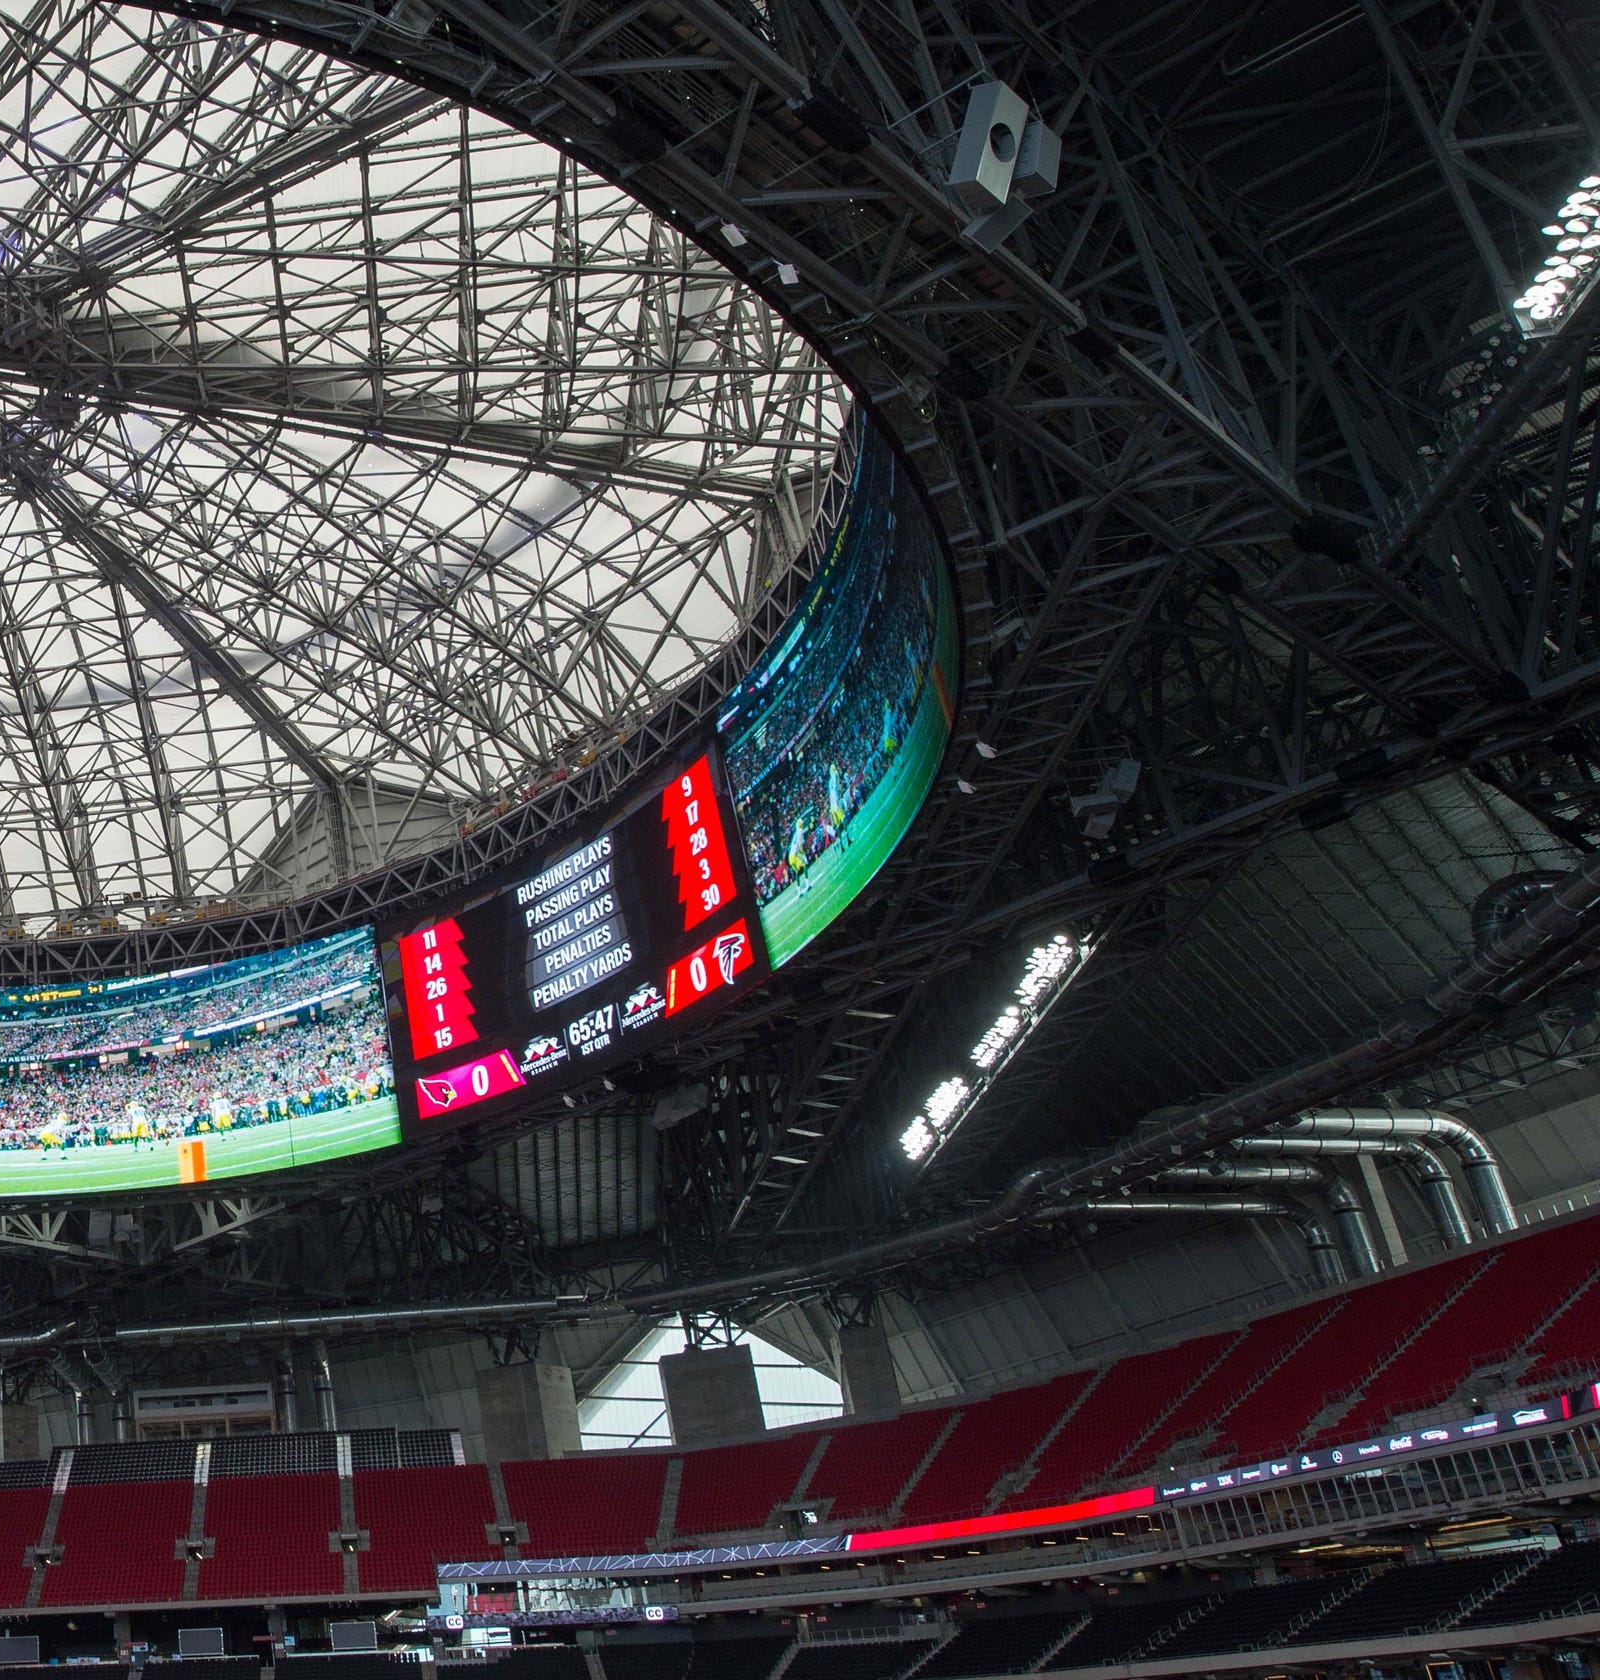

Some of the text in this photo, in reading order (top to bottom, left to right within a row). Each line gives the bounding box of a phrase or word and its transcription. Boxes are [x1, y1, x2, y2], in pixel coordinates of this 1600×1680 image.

[681, 775, 693, 797] 9
[685, 800, 699, 826] 17
[690, 827, 708, 857] 28
[517, 837, 612, 905] RUSHING PLAYS
[701, 858, 711, 880] 3
[526, 865, 611, 928] PASSING PLAY
[701, 884, 721, 912] 30
[534, 894, 614, 950] TOTAL PLAYS
[422, 929, 437, 949] 11
[544, 925, 612, 974] PENALTIES
[425, 953, 443, 975] 14
[533, 942, 632, 1008] PENALTY YARDS
[689, 957, 707, 992] 0
[426, 977, 447, 999] 26
[436, 1004, 445, 1022] 1
[568, 1004, 614, 1046] 65:47
[621, 998, 667, 1029] Mercedes-Benz
[632, 1011, 659, 1029] STADIUM
[435, 1027, 453, 1049] 15
[581, 1034, 611, 1056] 1ST QTR
[520, 1048, 568, 1075] Mercedes-Benz
[531, 1060, 559, 1076] STADIUM
[471, 1064, 489, 1096] 0
[1217, 1474, 1234, 1487] IBM
[647, 1609, 663, 1618] CC
